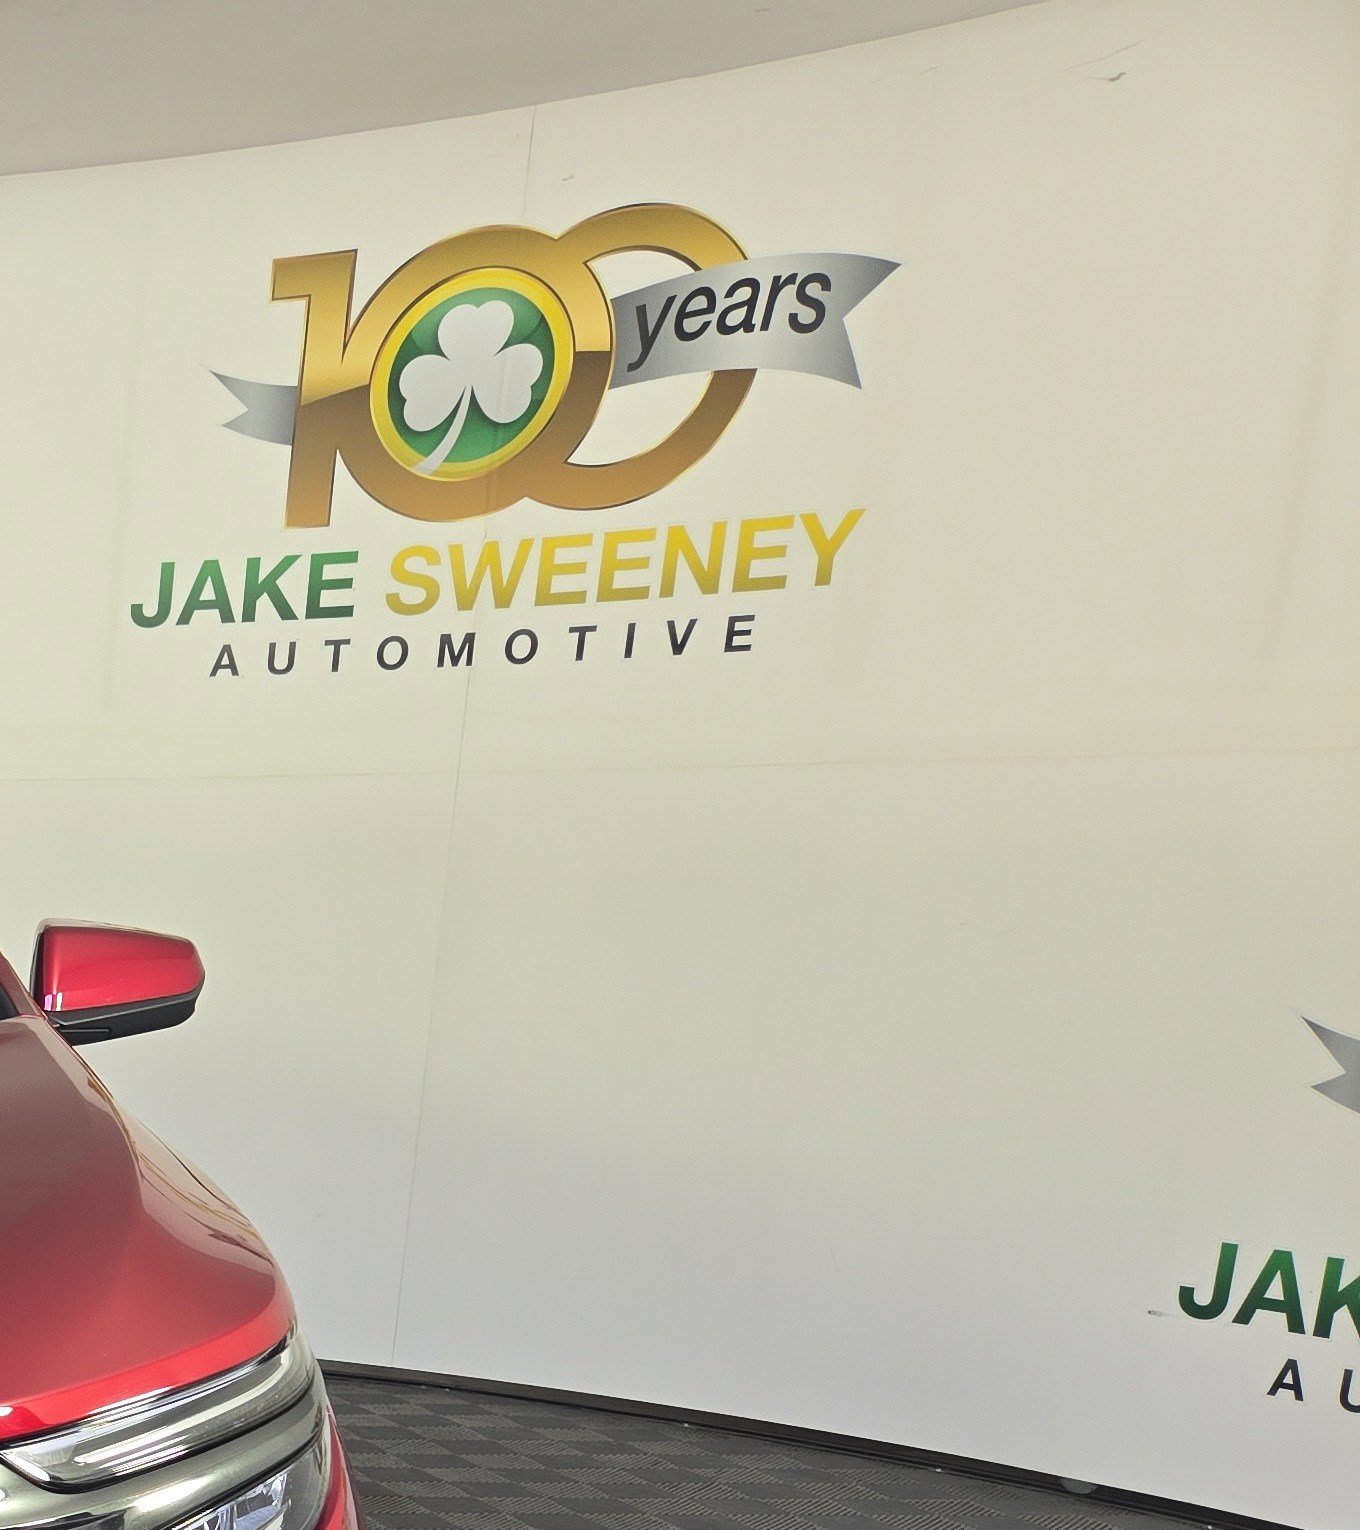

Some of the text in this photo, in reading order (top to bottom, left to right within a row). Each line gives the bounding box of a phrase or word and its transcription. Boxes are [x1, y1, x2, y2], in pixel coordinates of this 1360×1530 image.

[270, 202, 832, 528] 100 years
[129, 508, 866, 629] JAKE SWEENEY
[209, 613, 757, 678] AUTOMOTIVE
